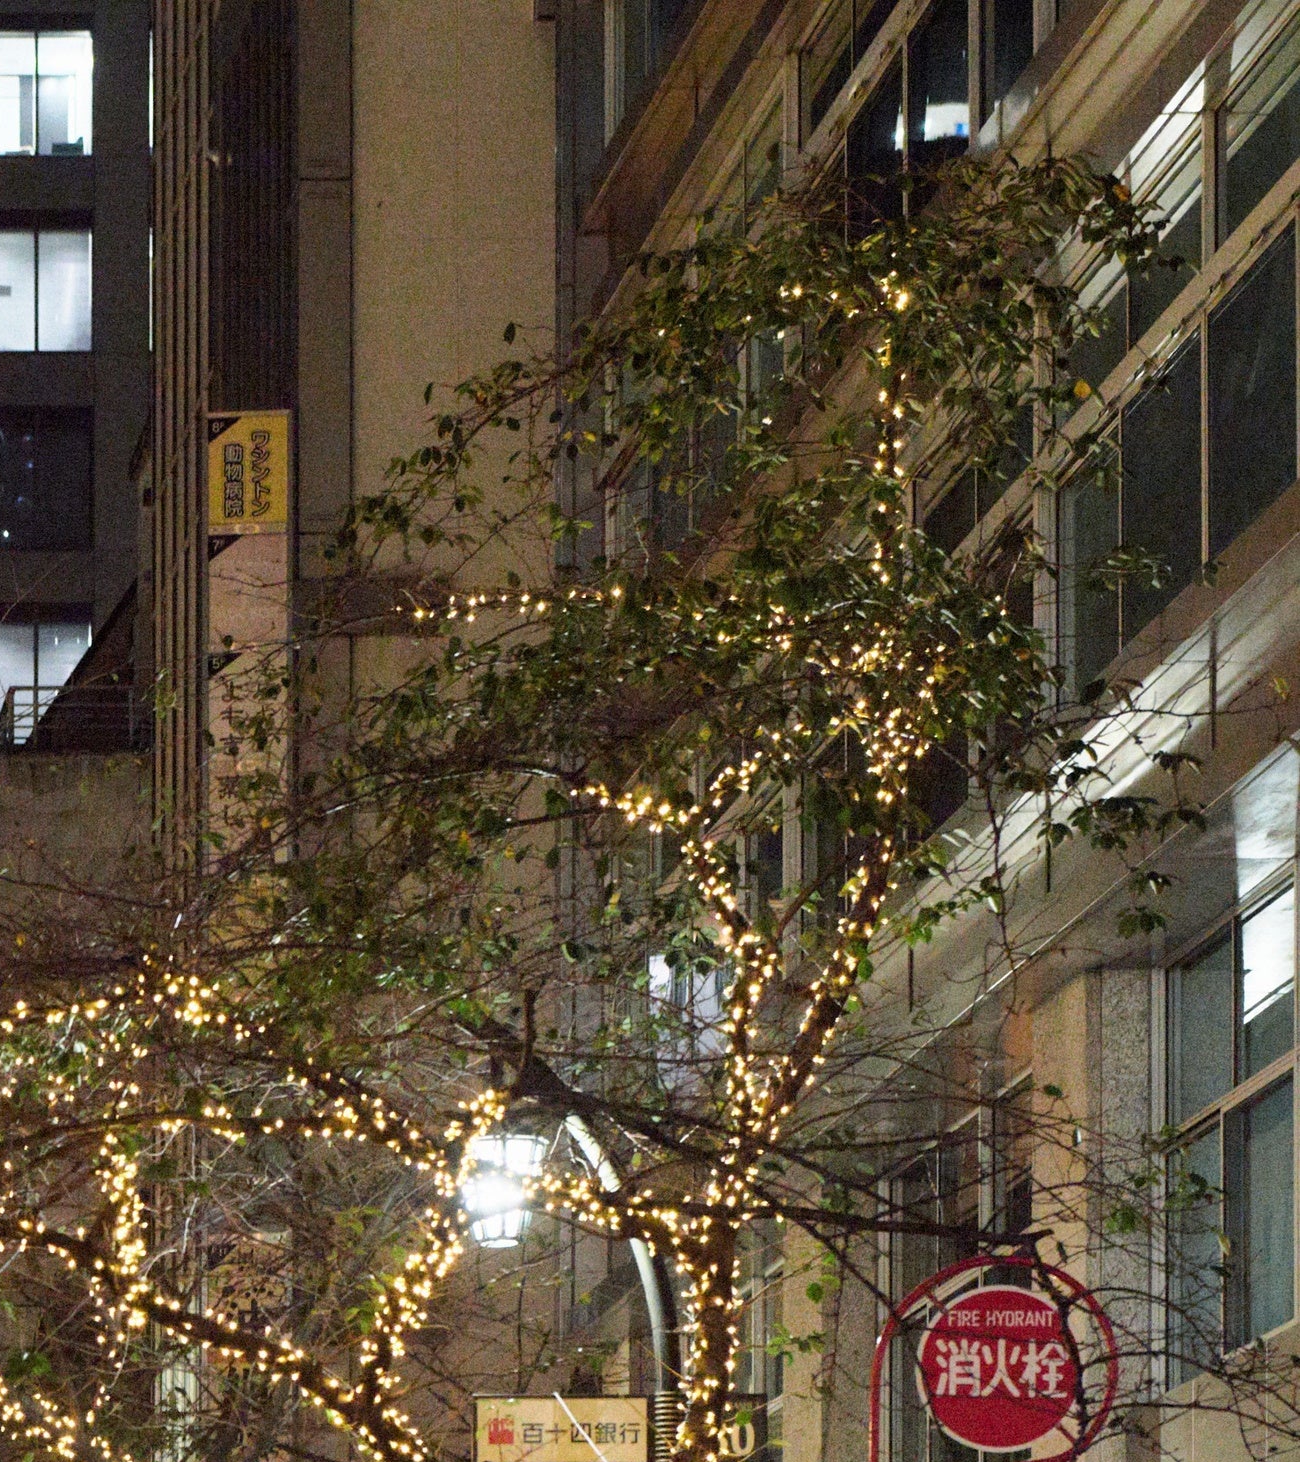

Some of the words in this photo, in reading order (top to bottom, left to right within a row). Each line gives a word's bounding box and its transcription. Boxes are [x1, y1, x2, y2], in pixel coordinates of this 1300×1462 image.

[224, 443, 244, 518] 動物病院
[251, 430, 271, 517] ワシントン
[948, 1310, 981, 1328] FIRE
[986, 1310, 1055, 1328] HYDRANT
[935, 1338, 1070, 1398] 消火栓
[521, 1422, 641, 1444] 百十四銀行
